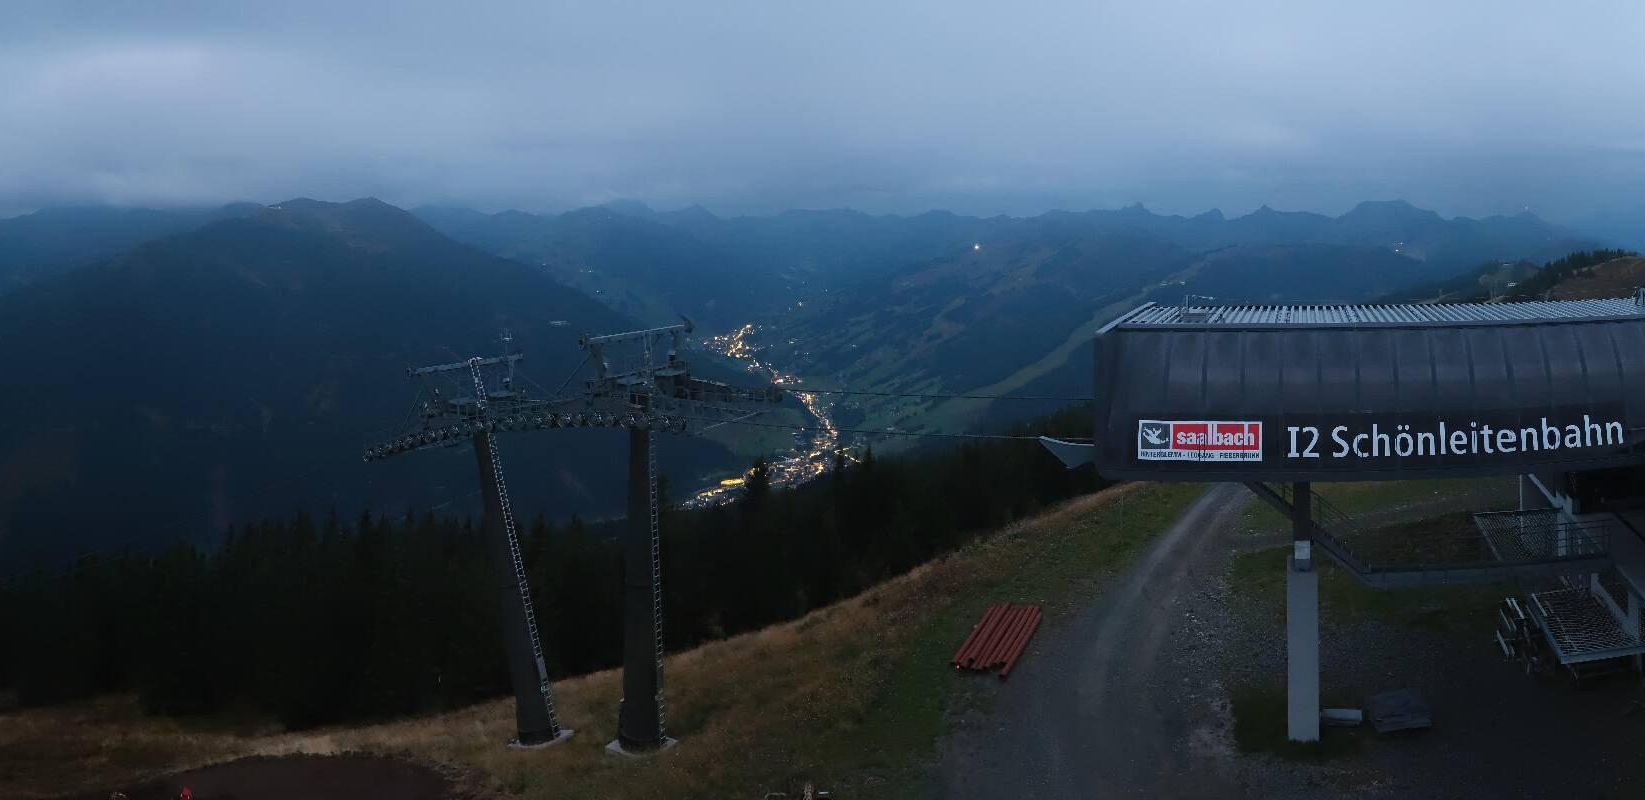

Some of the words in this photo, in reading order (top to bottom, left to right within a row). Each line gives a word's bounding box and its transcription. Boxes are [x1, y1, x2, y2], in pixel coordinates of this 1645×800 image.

[1176, 423, 1255, 446] saalbach
[1288, 426, 1320, 458] I2
[1332, 415, 1625, 458] Schönleitenbahn
